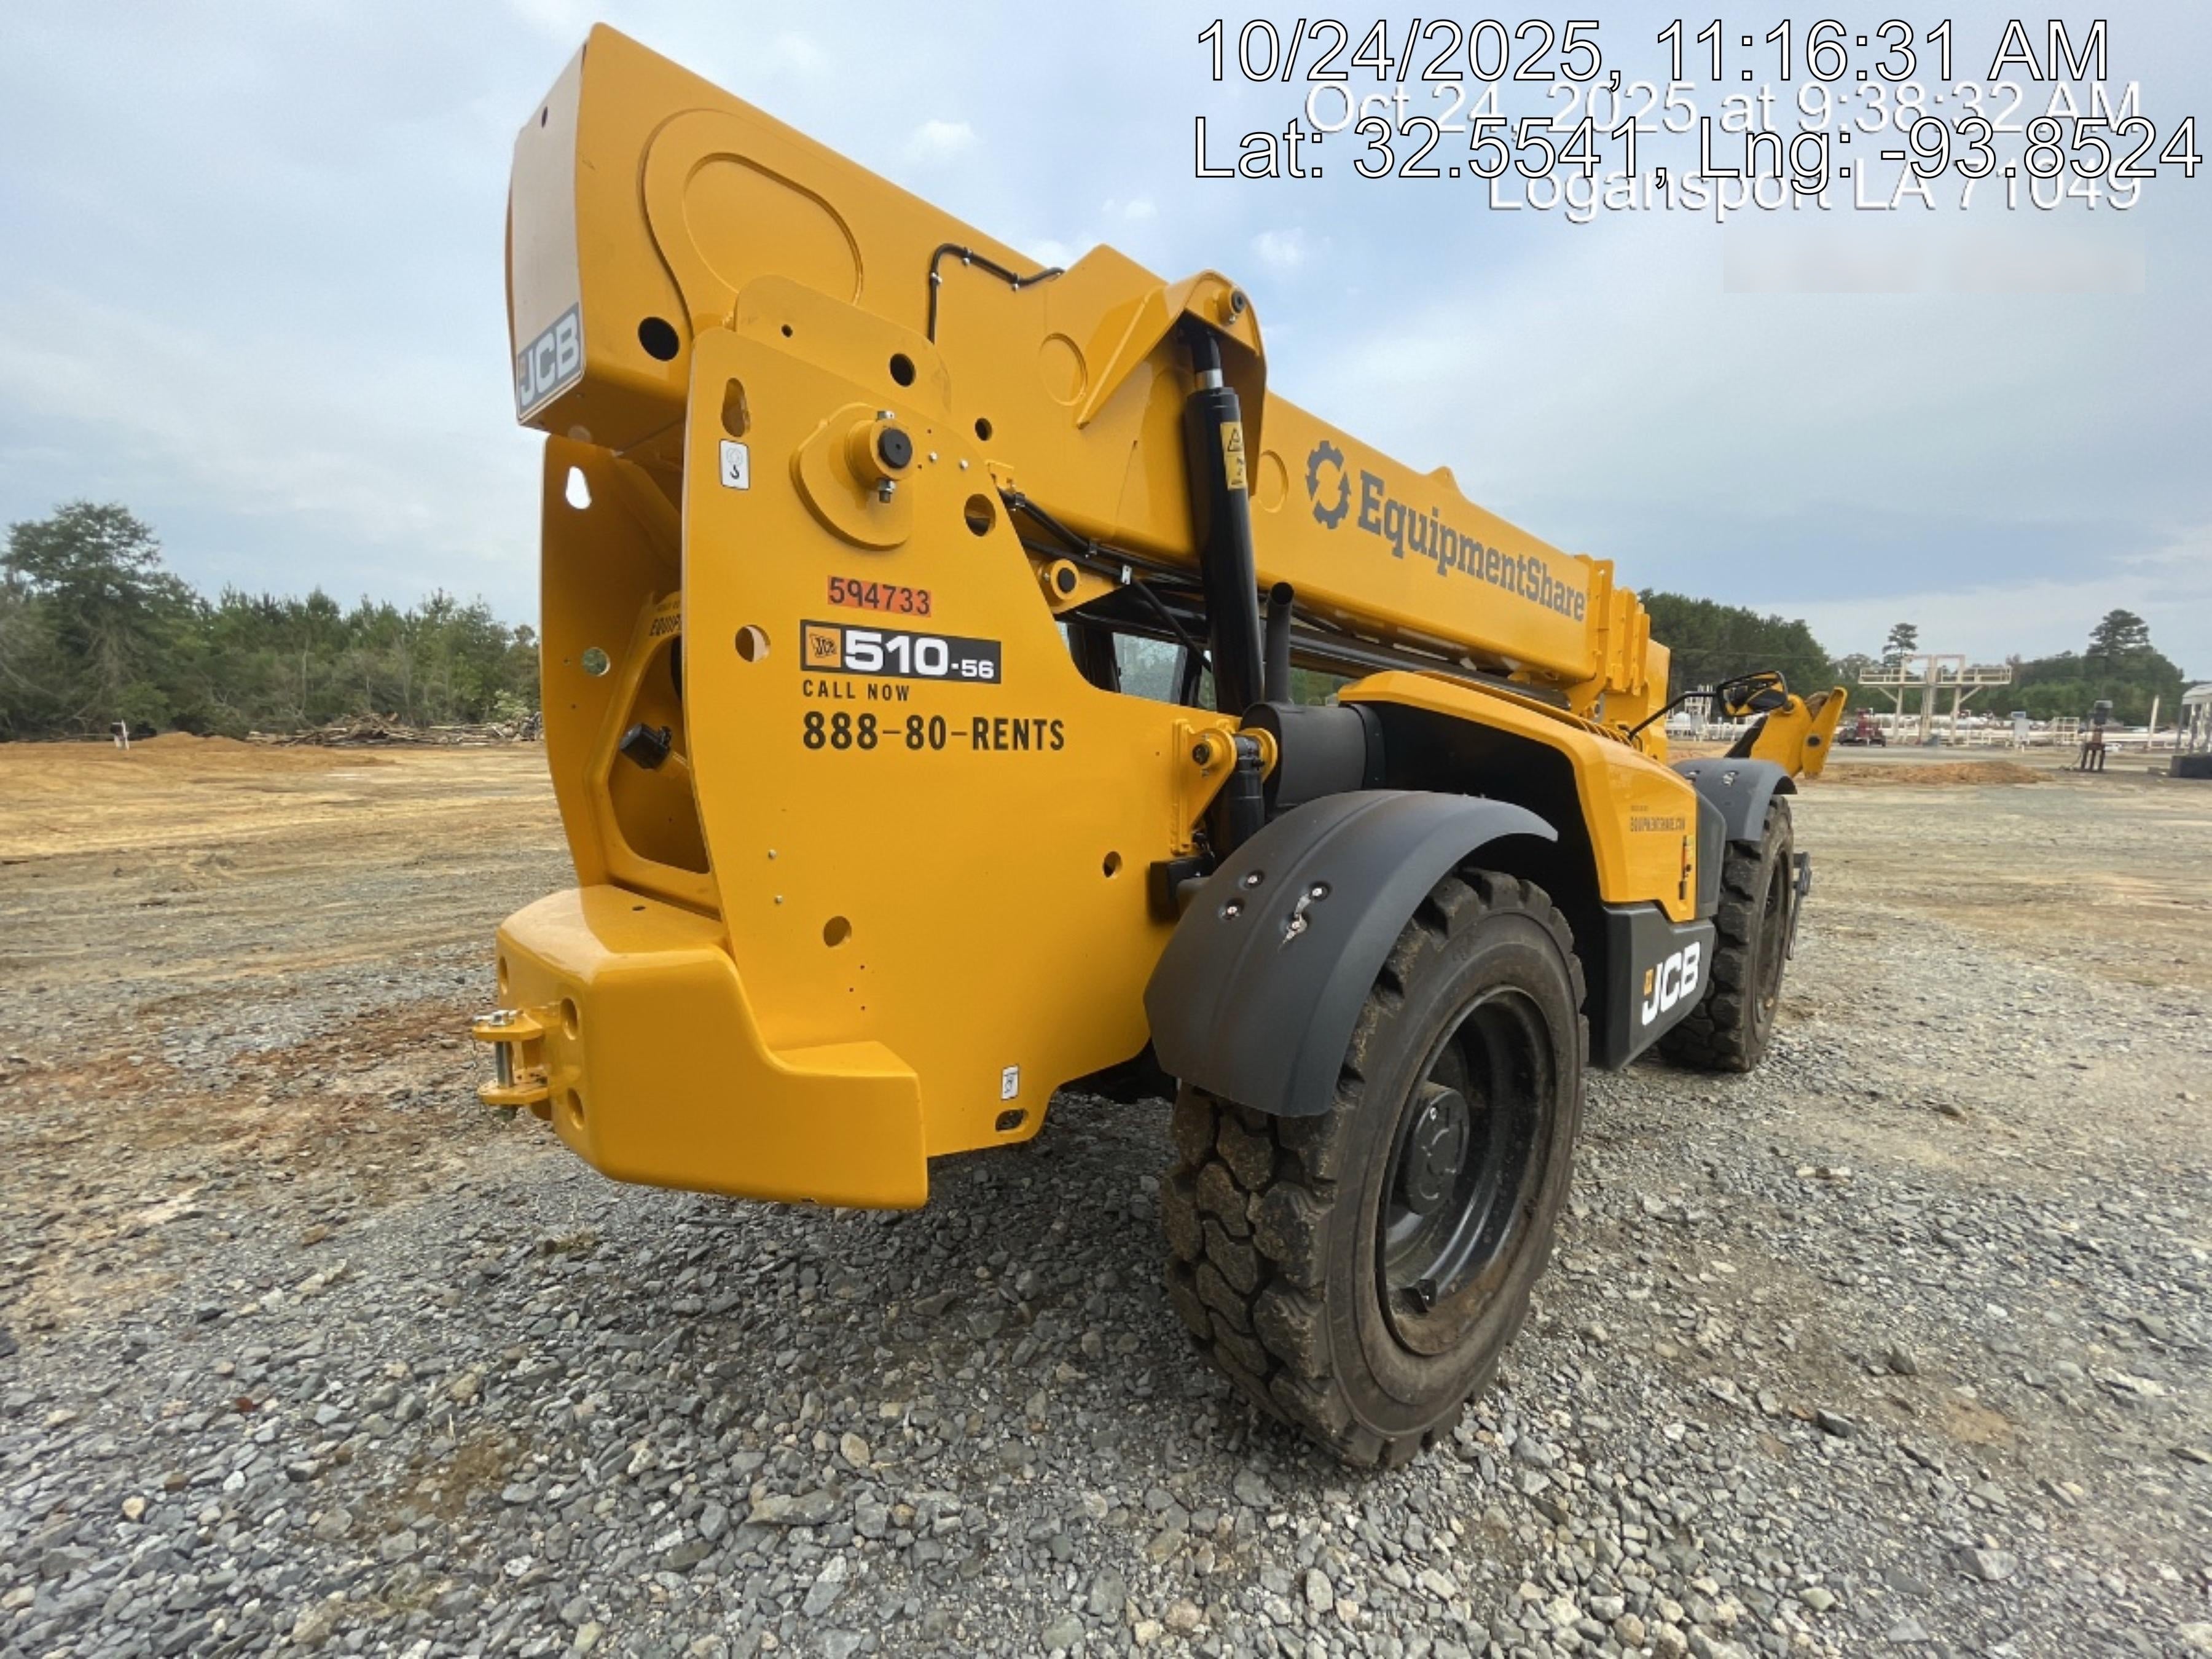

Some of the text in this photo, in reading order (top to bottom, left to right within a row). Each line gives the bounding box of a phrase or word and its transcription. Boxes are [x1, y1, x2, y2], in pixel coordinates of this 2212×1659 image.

[520, 313, 578, 407] JCB
[1358, 469, 1586, 622] EquipmentShare
[828, 576, 931, 615] 594733
[844, 629, 994, 679] 510-56
[802, 679, 910, 702] CALL NOW
[802, 710, 1065, 751] 888-80-RENTS
[1642, 941, 1700, 1026] JCB
